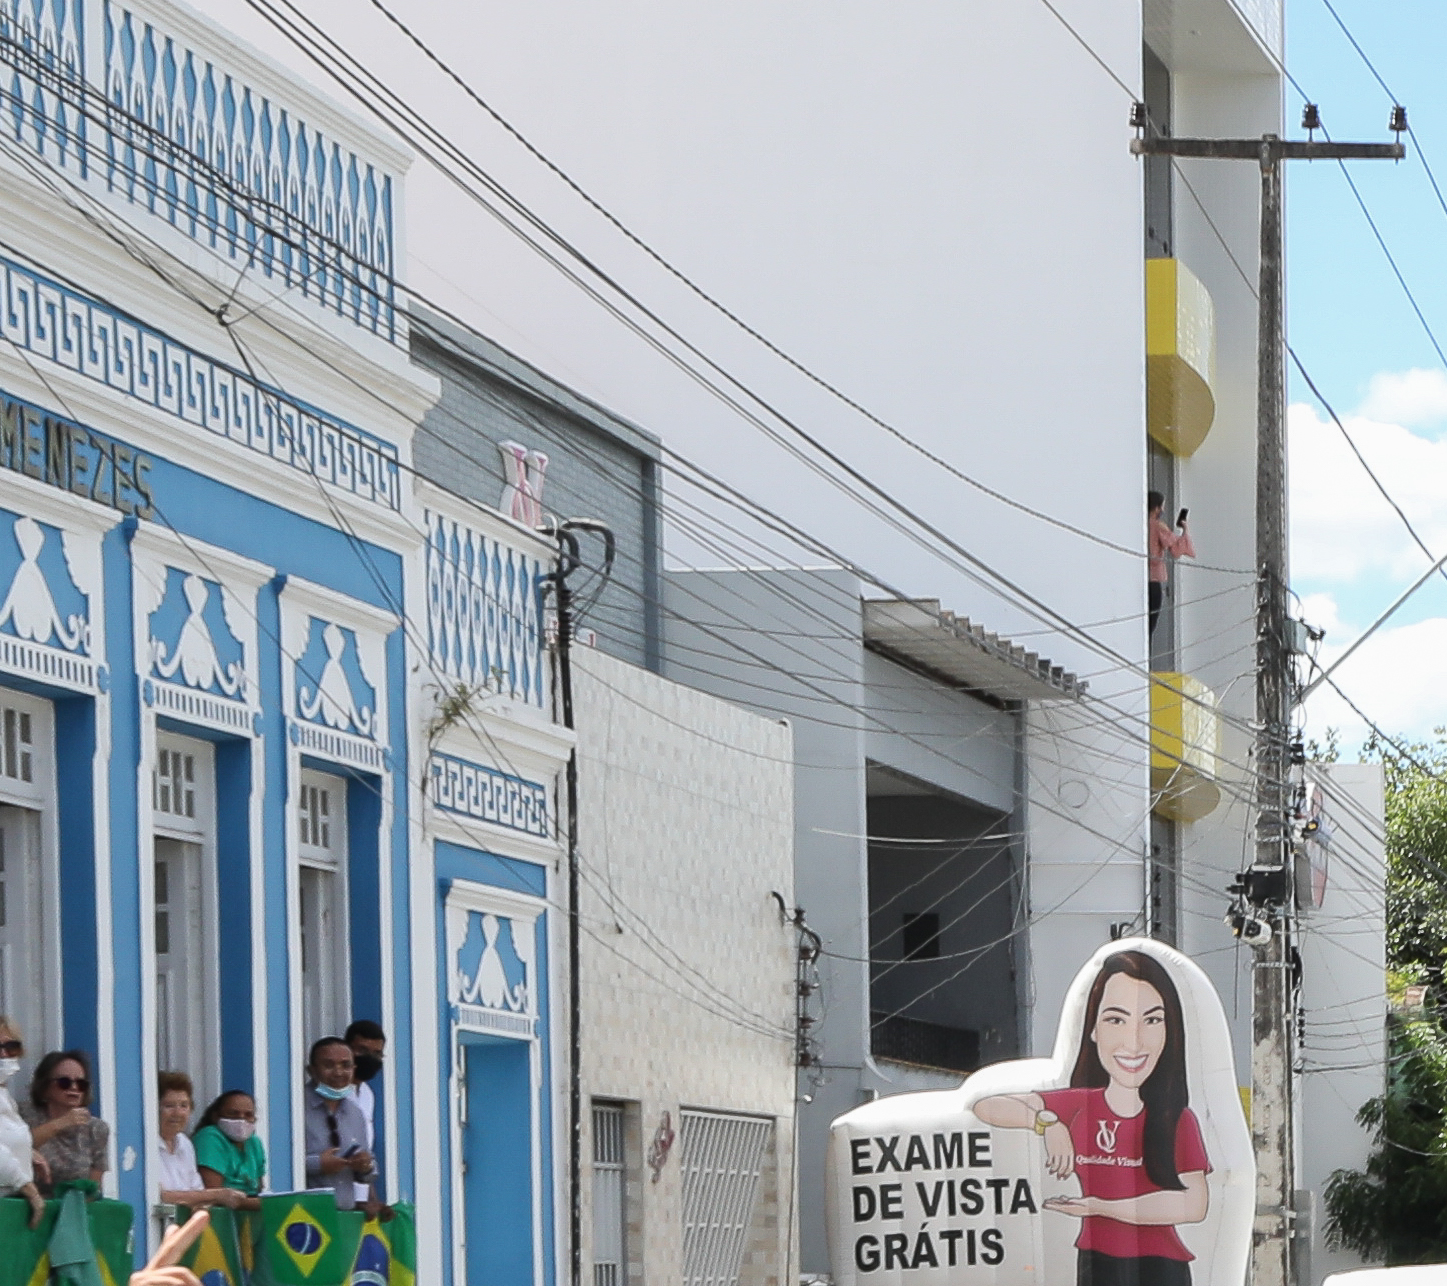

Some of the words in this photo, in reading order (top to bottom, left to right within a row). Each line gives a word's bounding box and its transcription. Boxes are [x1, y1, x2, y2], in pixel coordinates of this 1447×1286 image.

[850, 1132, 993, 1176] EXAME
[852, 1184, 904, 1223] DE
[915, 1178, 1038, 1218] VISTA
[855, 1222, 1004, 1272] GRÁTIS
